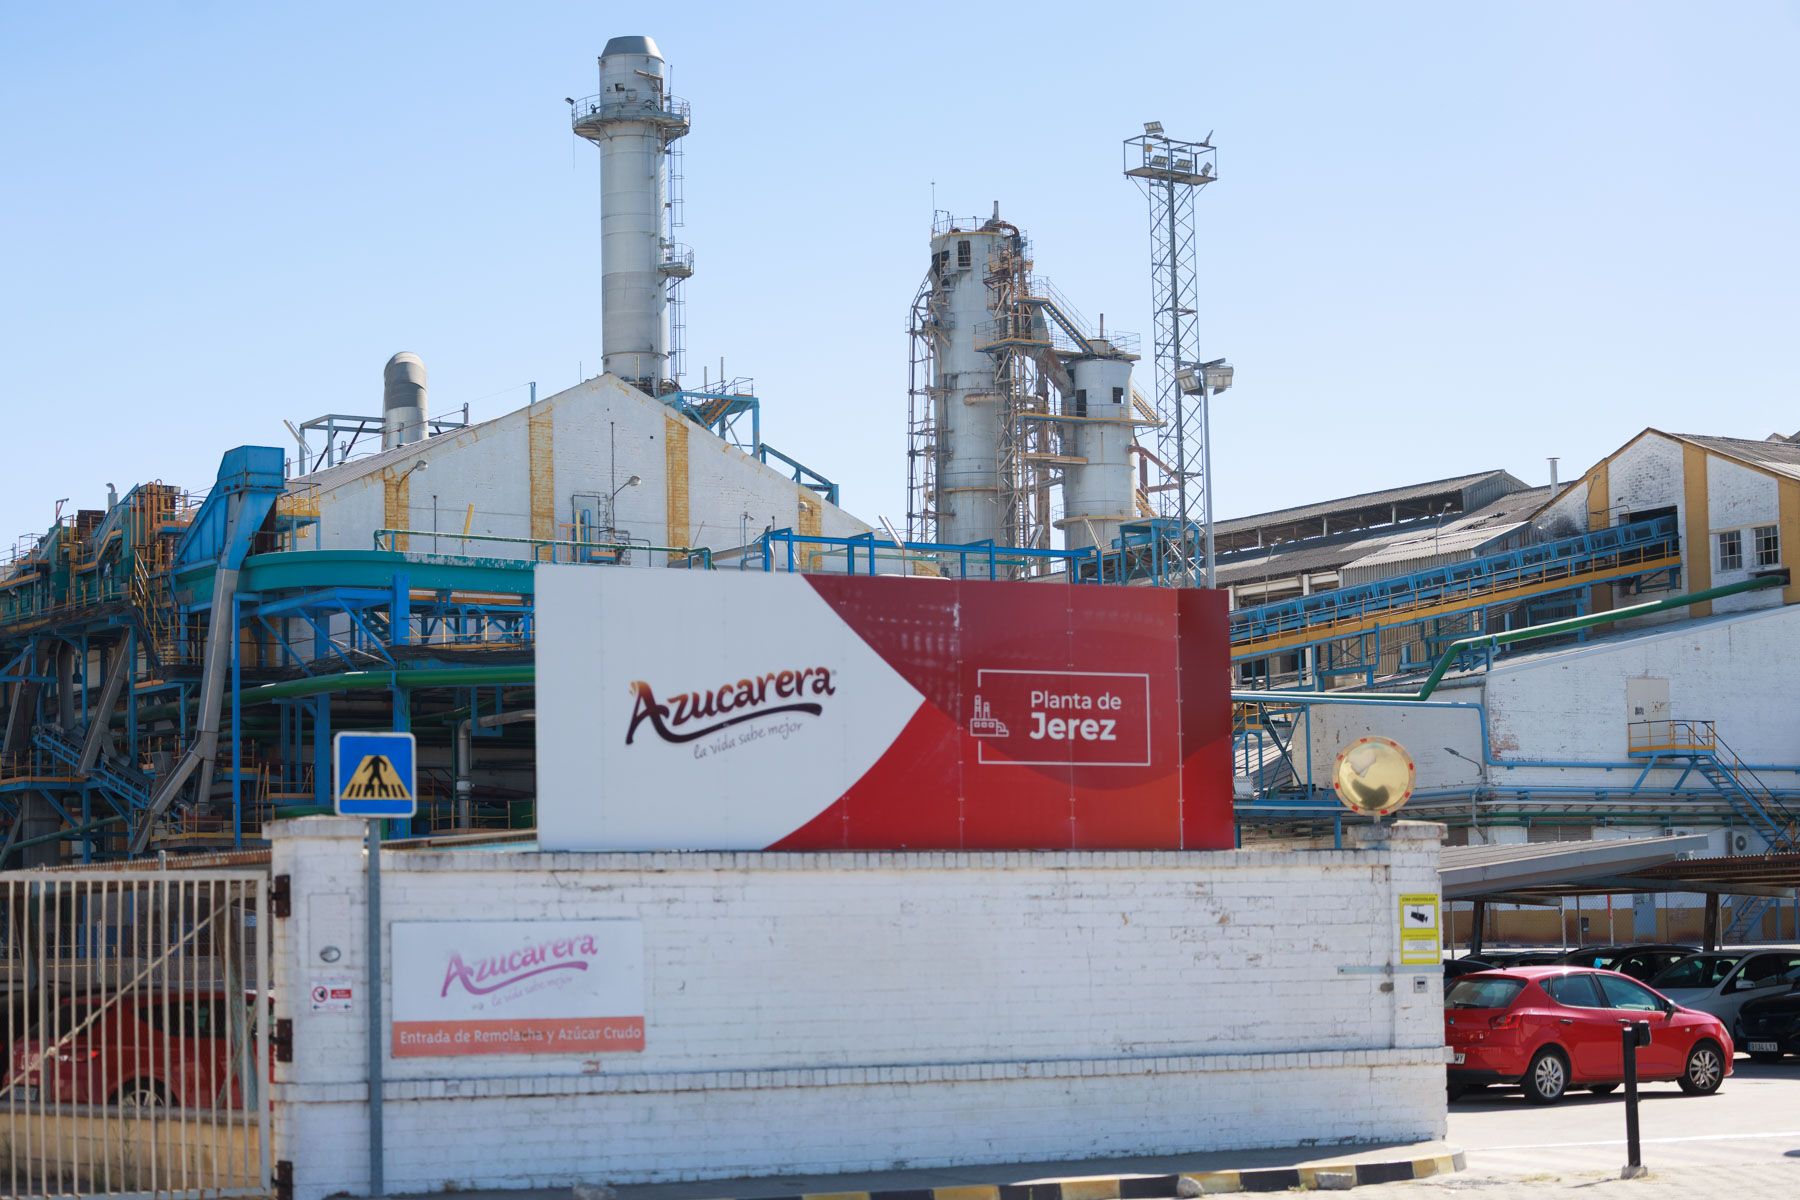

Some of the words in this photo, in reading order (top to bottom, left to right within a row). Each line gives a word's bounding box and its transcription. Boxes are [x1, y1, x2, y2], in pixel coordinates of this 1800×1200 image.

[625, 666, 836, 745] Azucarera
[1030, 690, 1092, 710] Planta
[1097, 691, 1123, 710] de
[712, 733, 736, 754] vida
[738, 724, 765, 745] sabe
[768, 716, 803, 740] mejor
[1029, 711, 1117, 741] Jerez
[440, 934, 598, 998] Azucarera
[399, 1030, 450, 1045] Entrada
[454, 1028, 470, 1043] de
[474, 1028, 545, 1043] Remolacha
[546, 1030, 555, 1044] y
[558, 1026, 601, 1042] Azúcar
[604, 1025, 642, 1040] Crudo
